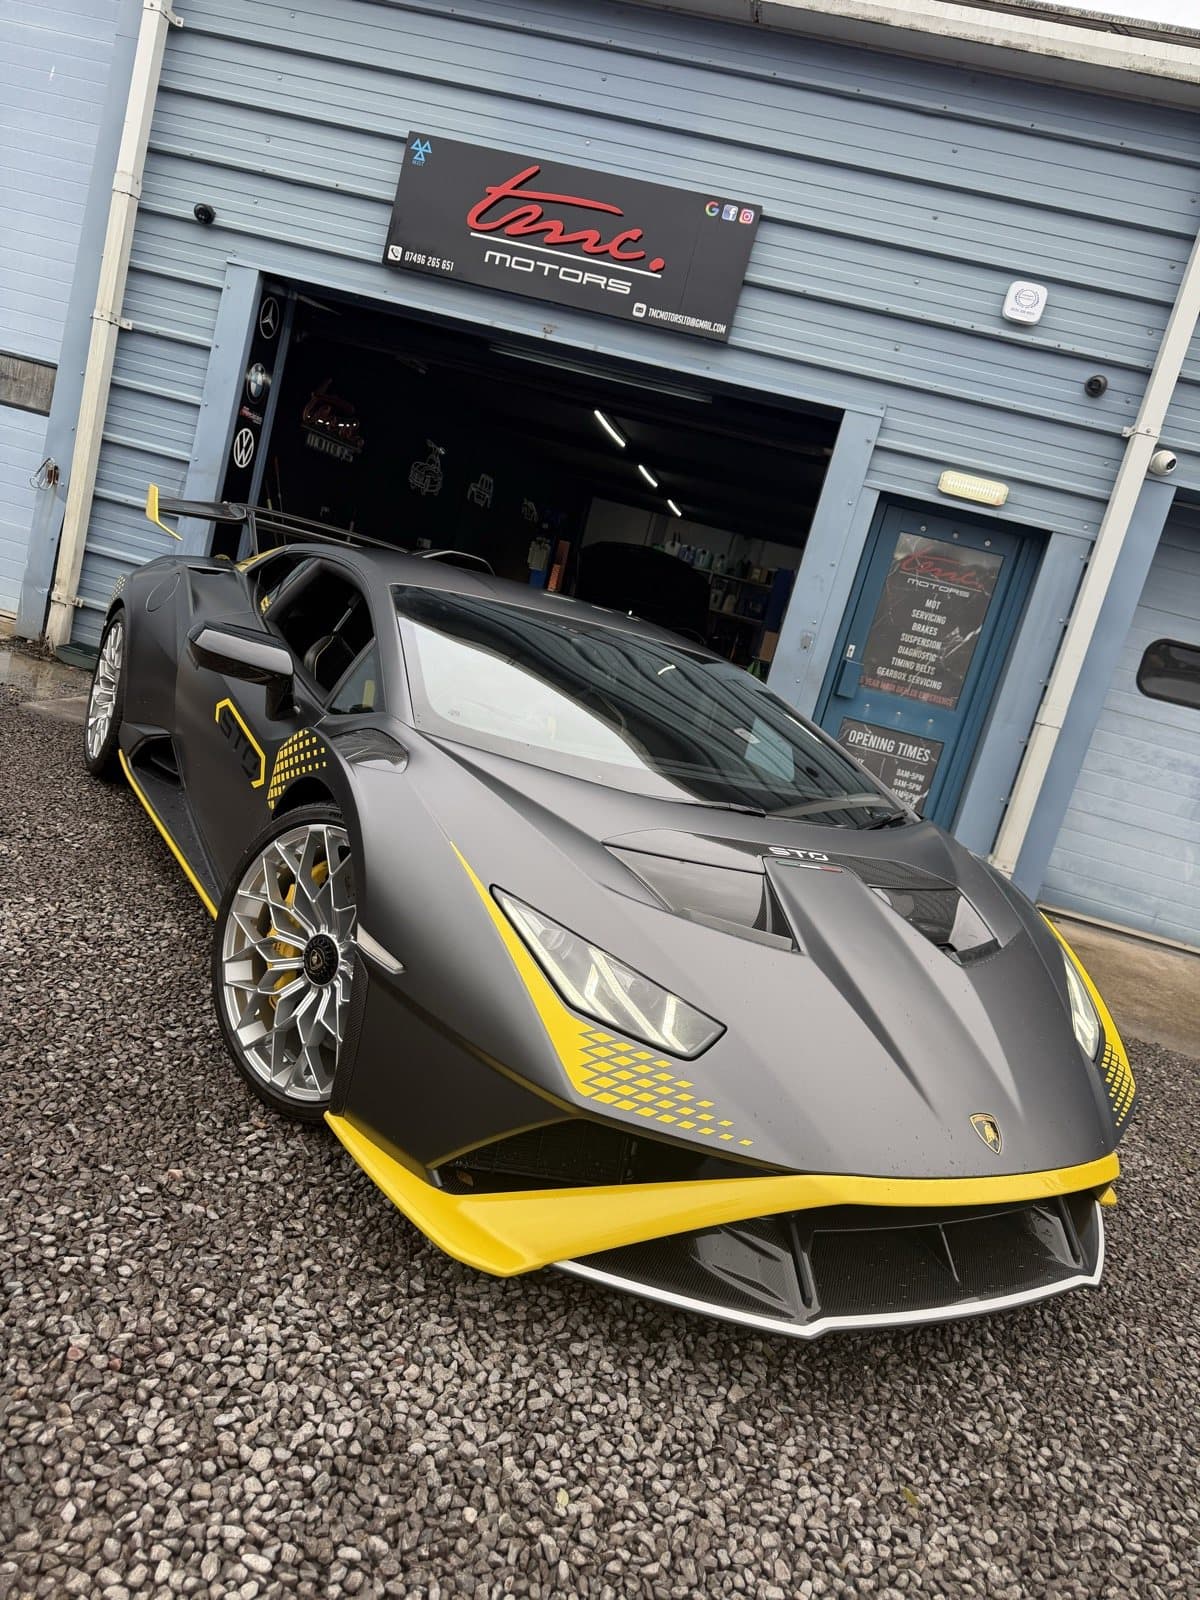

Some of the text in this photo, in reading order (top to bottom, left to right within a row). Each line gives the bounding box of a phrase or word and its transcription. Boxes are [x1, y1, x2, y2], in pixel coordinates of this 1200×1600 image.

[404, 251, 454, 271] 07496 265 651
[484, 250, 632, 294] MOTORS
[907, 577, 970, 598] MOTORS
[925, 599, 941, 610] MOT
[911, 608, 947, 625] SERVICING
[912, 622, 938, 636] BRAKES
[900, 633, 942, 650] SUSPENSION
[891, 656, 936, 675] TIMING BELTS
[876, 666, 908, 681] GEARBOX
[907, 674, 942, 690] SERVICING
[848, 730, 931, 762] OPENING TIMES
[768, 846, 829, 861] STO
